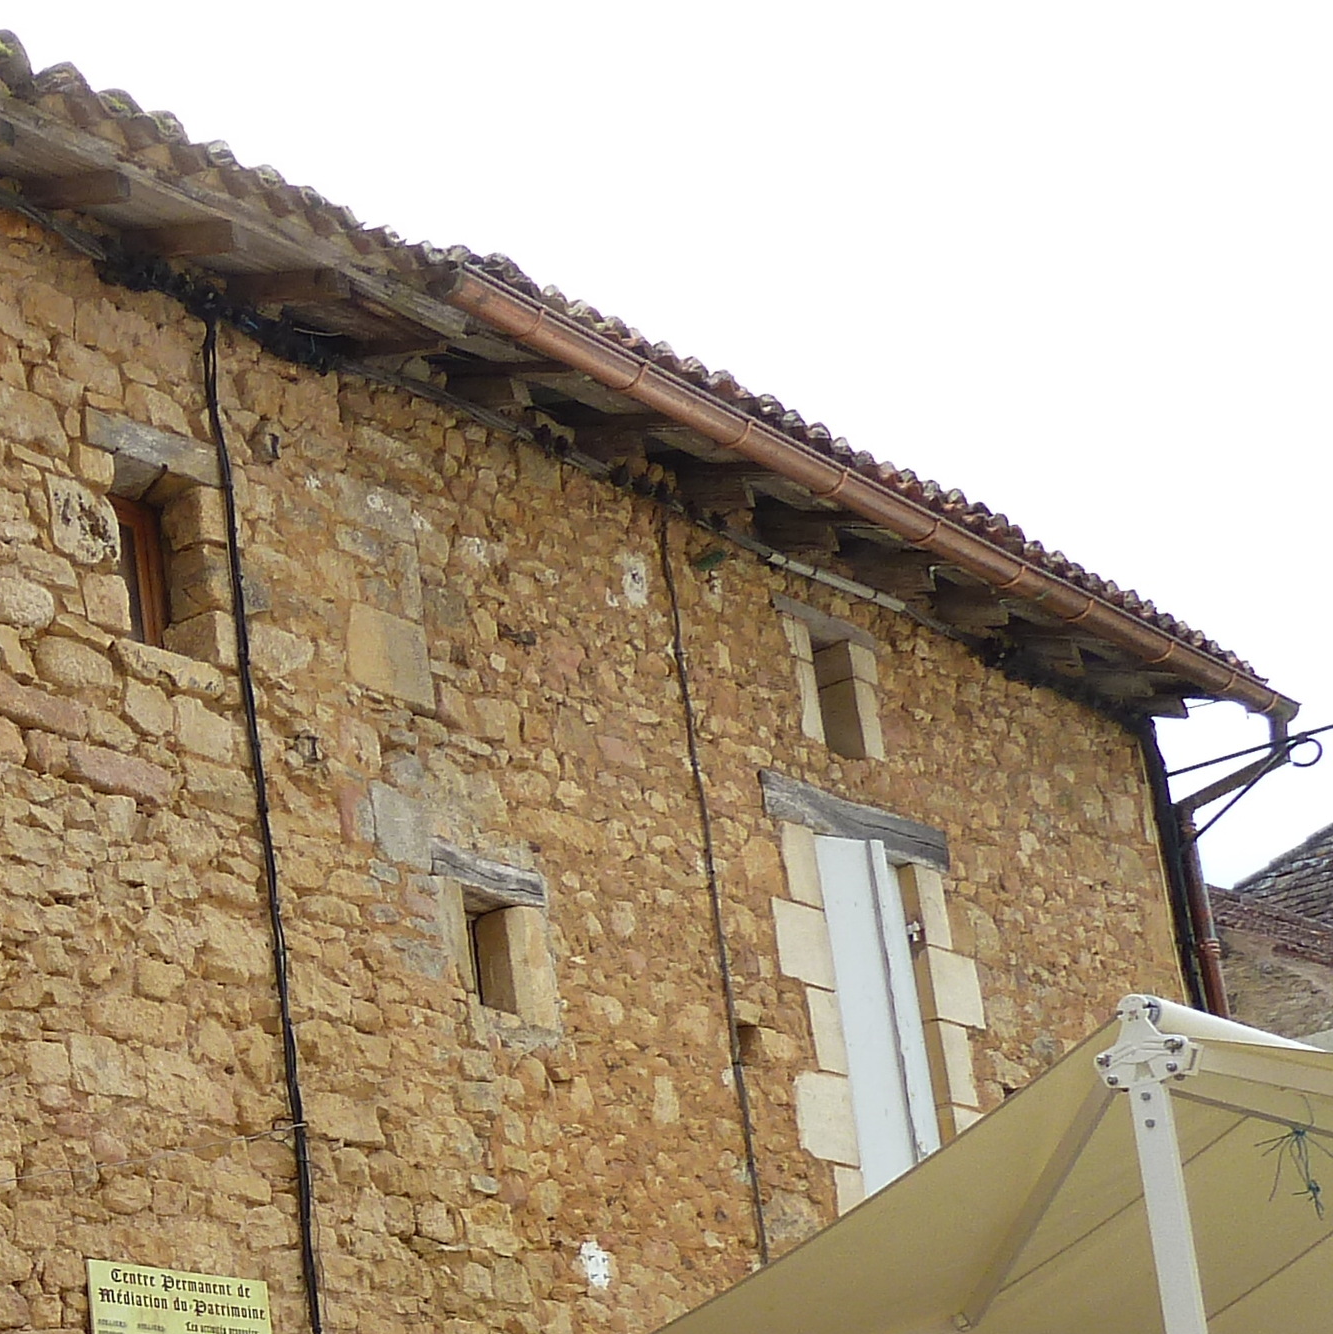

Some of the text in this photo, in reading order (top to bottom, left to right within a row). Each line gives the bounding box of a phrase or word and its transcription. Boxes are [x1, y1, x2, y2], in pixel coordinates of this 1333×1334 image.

[111, 1268, 251, 1298] Centre Permanent de
[98, 1288, 266, 1320] Médiation du Patrimoine
